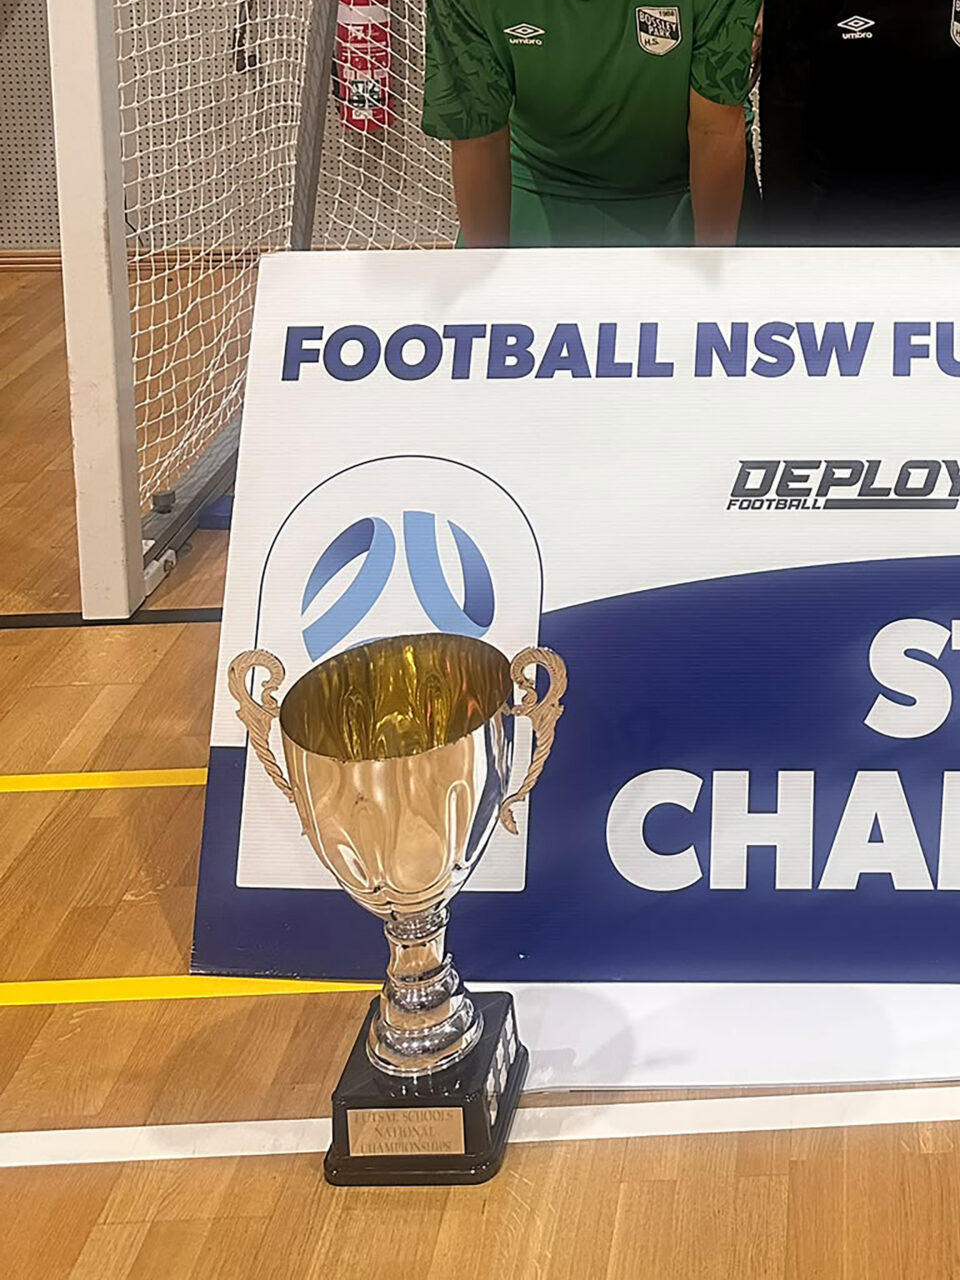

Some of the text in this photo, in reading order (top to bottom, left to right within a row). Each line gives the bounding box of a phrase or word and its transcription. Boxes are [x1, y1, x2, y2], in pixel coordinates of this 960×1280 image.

[639, 10, 677, 31] BOSSLEY
[509, 38, 543, 46] umbro
[842, 31, 873, 40] umbro
[281, 323, 675, 382] FOOTBALL
[694, 321, 875, 378] NSW
[726, 498, 823, 511] FOOTBALL
[402, 1108, 454, 1123] SCHOOLS
[374, 1125, 436, 1139] NATIONAL
[360, 1140, 453, 1154] CHAMPIONSHIPS
